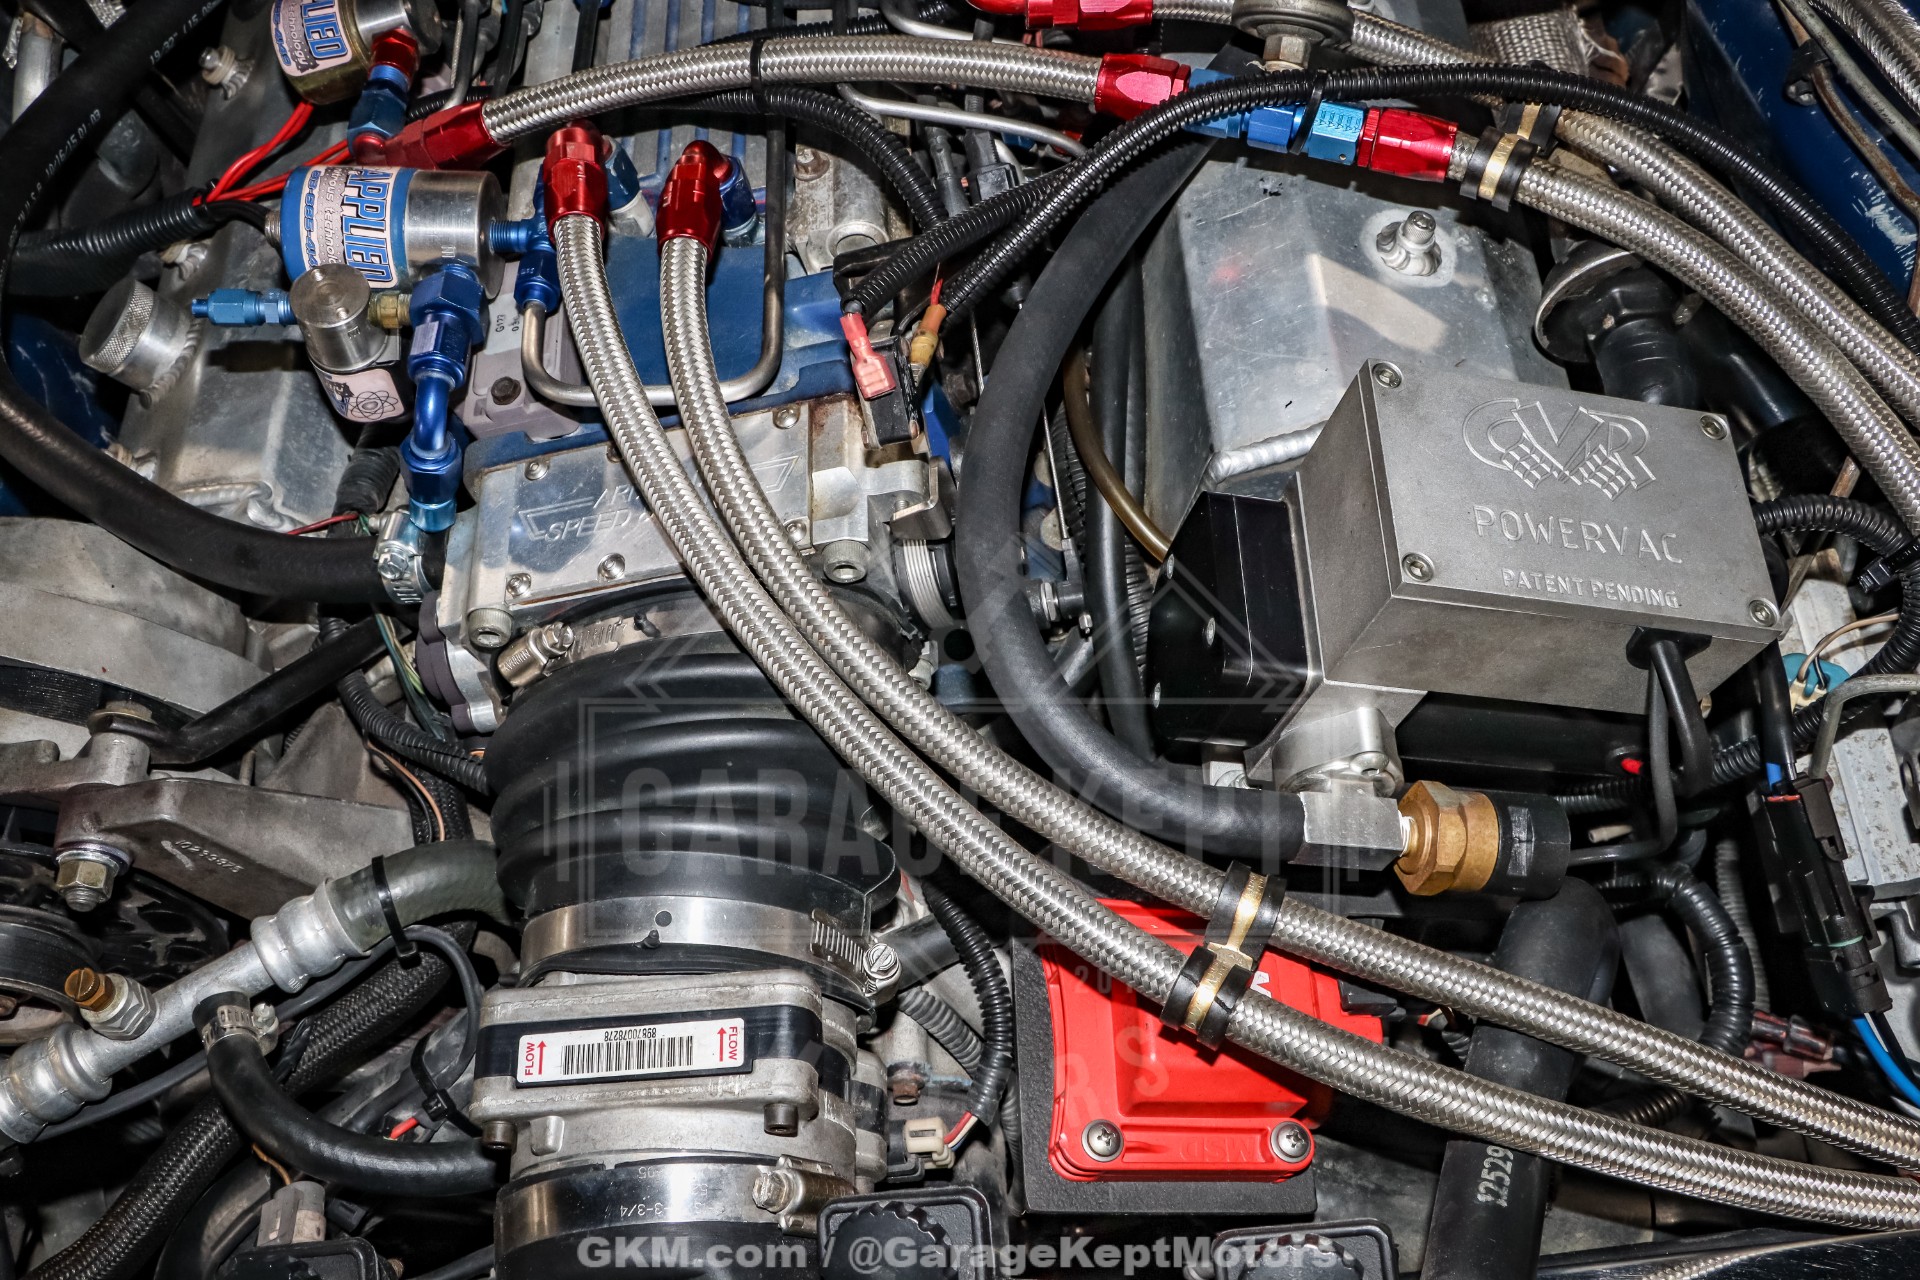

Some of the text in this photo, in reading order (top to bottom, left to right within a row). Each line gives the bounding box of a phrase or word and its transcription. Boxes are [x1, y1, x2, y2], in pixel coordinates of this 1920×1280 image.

[544, 509, 631, 542] SPEED
[1501, 568, 1680, 609] PATENT PENDING
[524, 1042, 535, 1076] FLOW
[728, 1026, 738, 1061] FLOW
